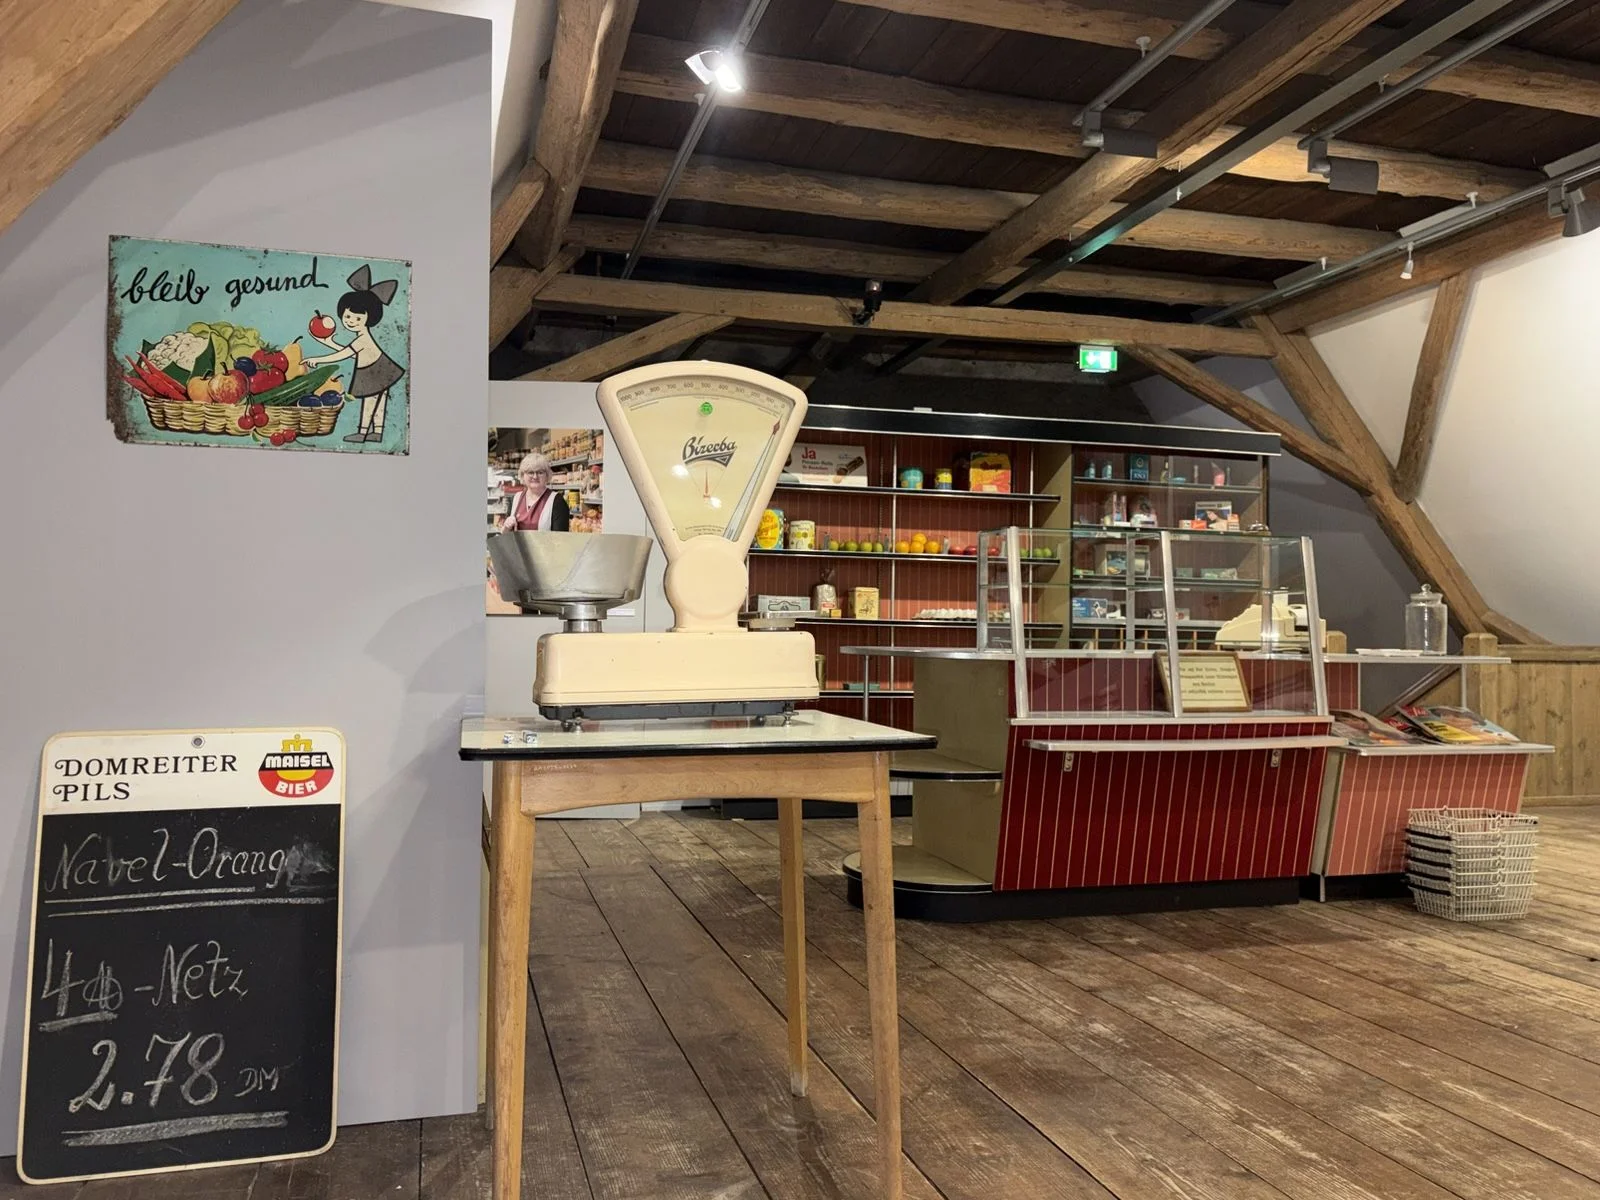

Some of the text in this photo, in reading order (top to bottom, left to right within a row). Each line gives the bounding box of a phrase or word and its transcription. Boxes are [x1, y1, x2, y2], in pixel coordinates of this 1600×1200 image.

[121, 256, 329, 308] bleib gesund
[682, 435, 737, 460] Bizerba
[801, 446, 817, 460] Ja
[54, 754, 238, 777] DOMREITER
[265, 754, 331, 768] MAISEL
[52, 782, 131, 803] PILS
[275, 780, 318, 795] BIER
[68, 1032, 283, 1114] 2.78 DM
